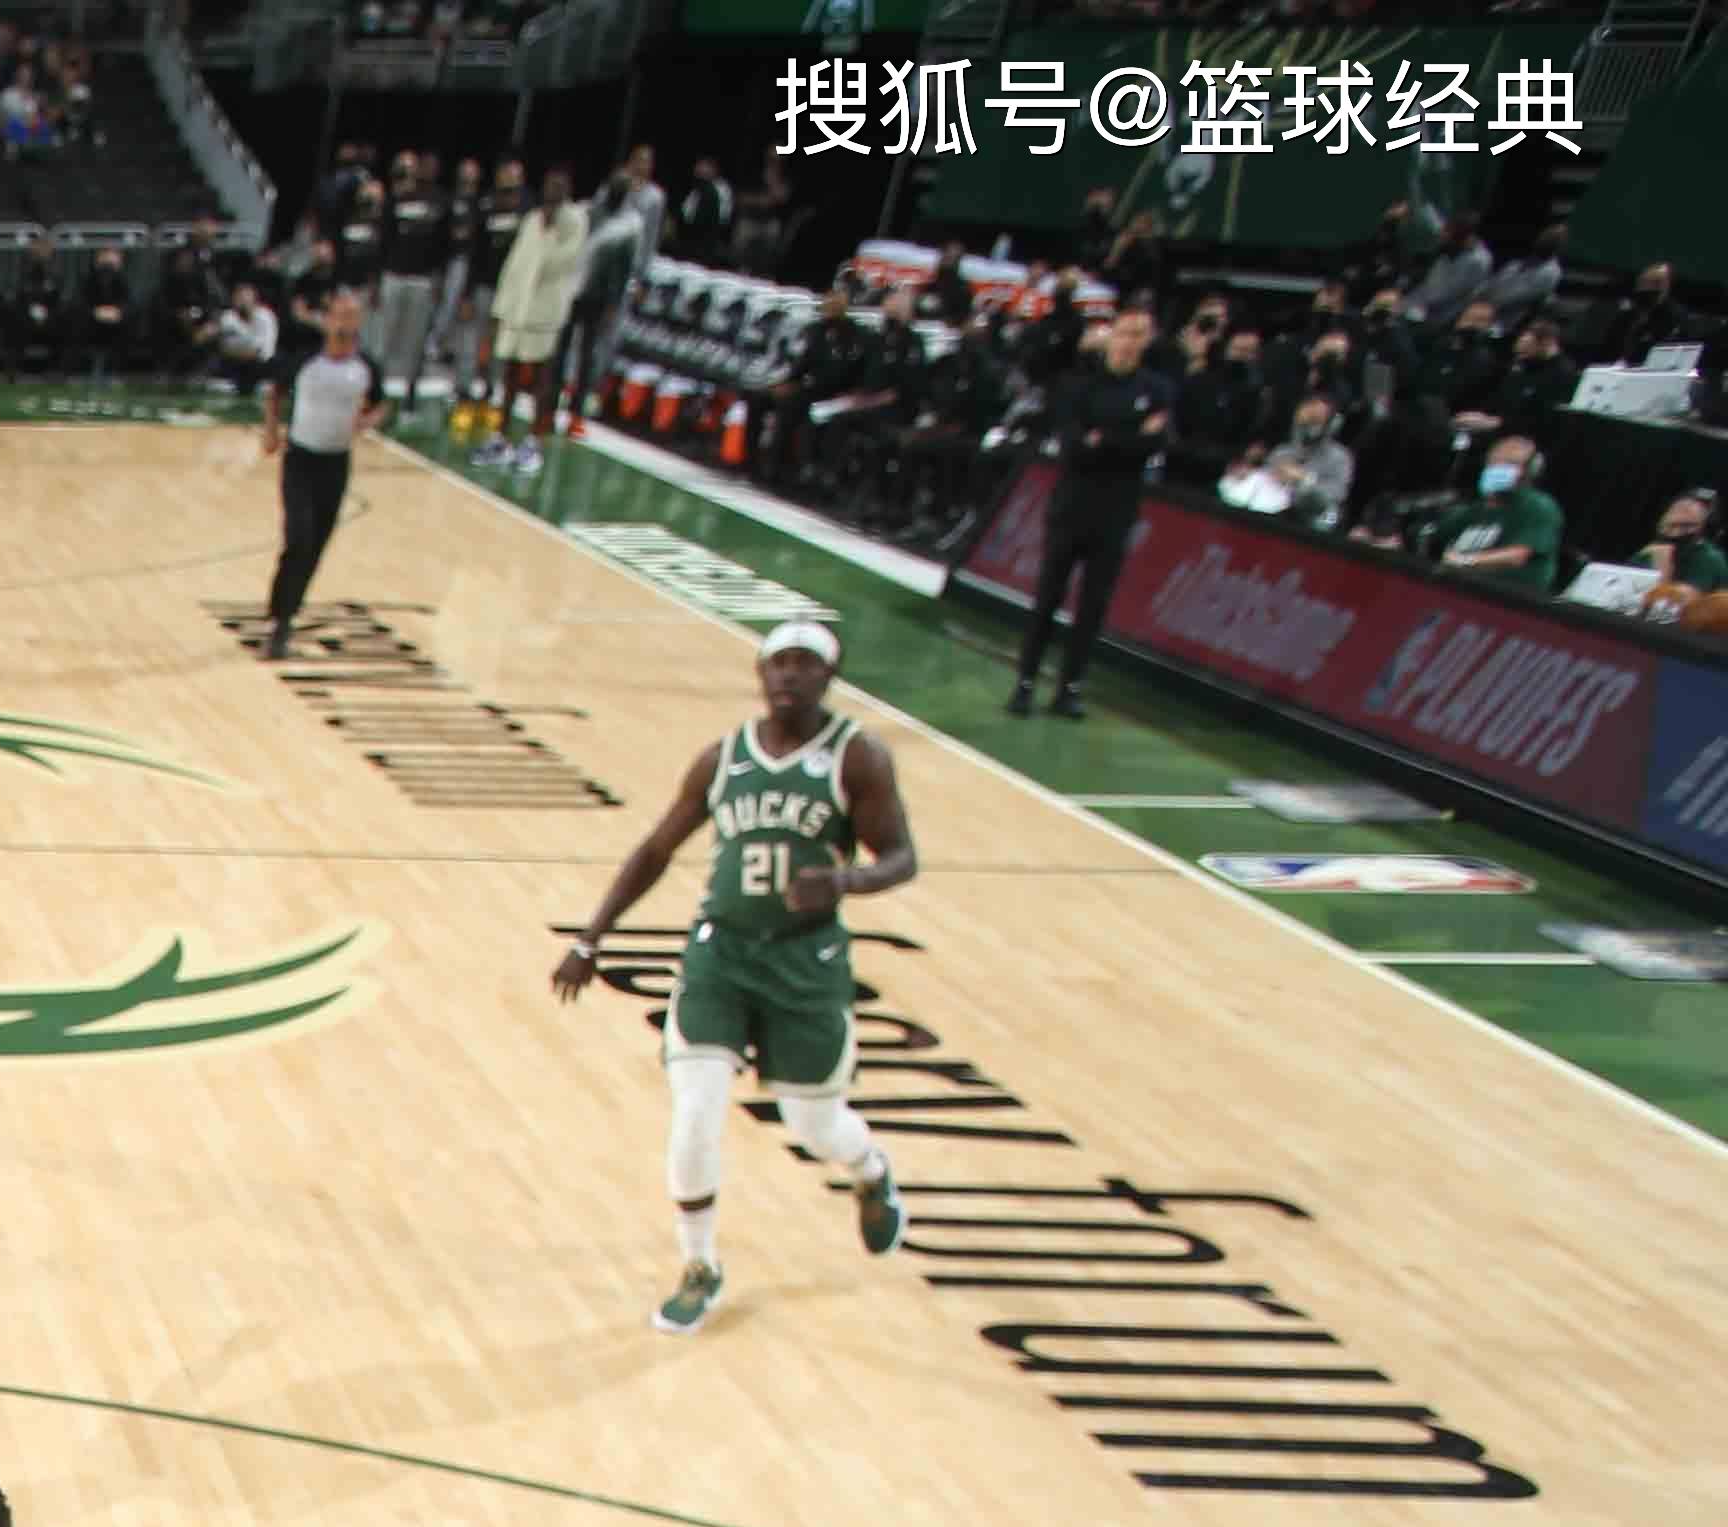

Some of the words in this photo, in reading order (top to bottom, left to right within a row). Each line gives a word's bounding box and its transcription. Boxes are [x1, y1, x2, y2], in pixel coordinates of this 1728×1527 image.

[1393, 622, 1639, 777] PLAYOFFS
[715, 790, 833, 840] BUCKS
[740, 842, 790, 896] 21
[824, 1176, 1540, 1501] forum
